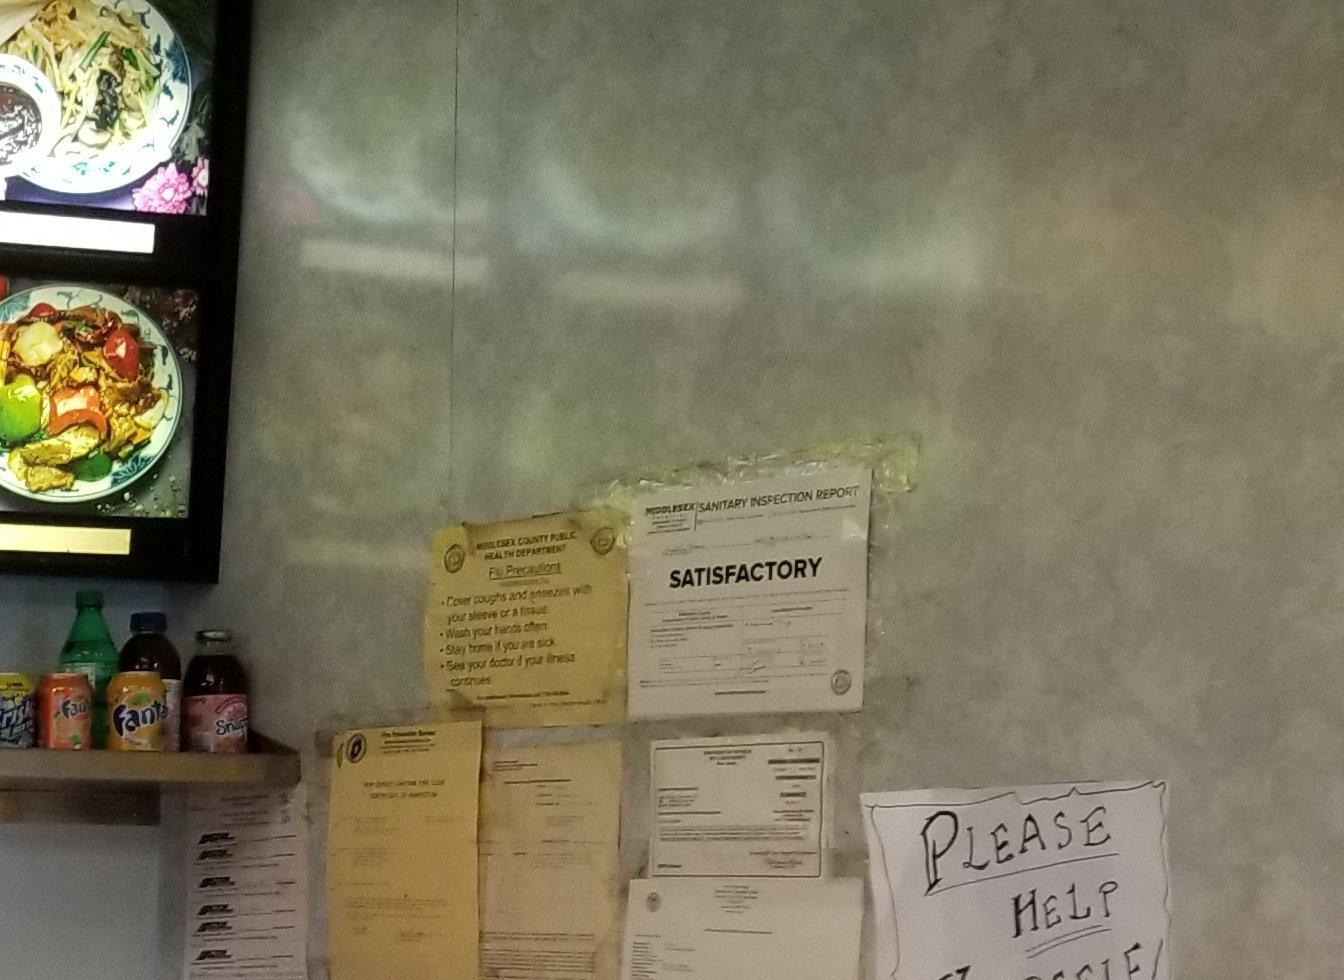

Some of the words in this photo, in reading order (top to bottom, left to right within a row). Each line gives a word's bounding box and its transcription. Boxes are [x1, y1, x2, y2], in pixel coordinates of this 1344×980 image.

[698, 498, 749, 513] SANITARY
[750, 490, 813, 507] INSPECTION
[815, 485, 860, 500] REPORT
[517, 534, 549, 546] COUNTY
[550, 531, 577, 543] PUBLIC
[484, 549, 514, 561] HEALTH
[515, 544, 567, 558] DEPARTMENT
[506, 562, 561, 576] Precautions
[669, 556, 823, 589] SATISFACTORY
[473, 592, 507, 606] coughs
[509, 589, 528, 601] and
[920, 805, 1111, 896] PLEASE
[1012, 880, 1118, 939] HELP
